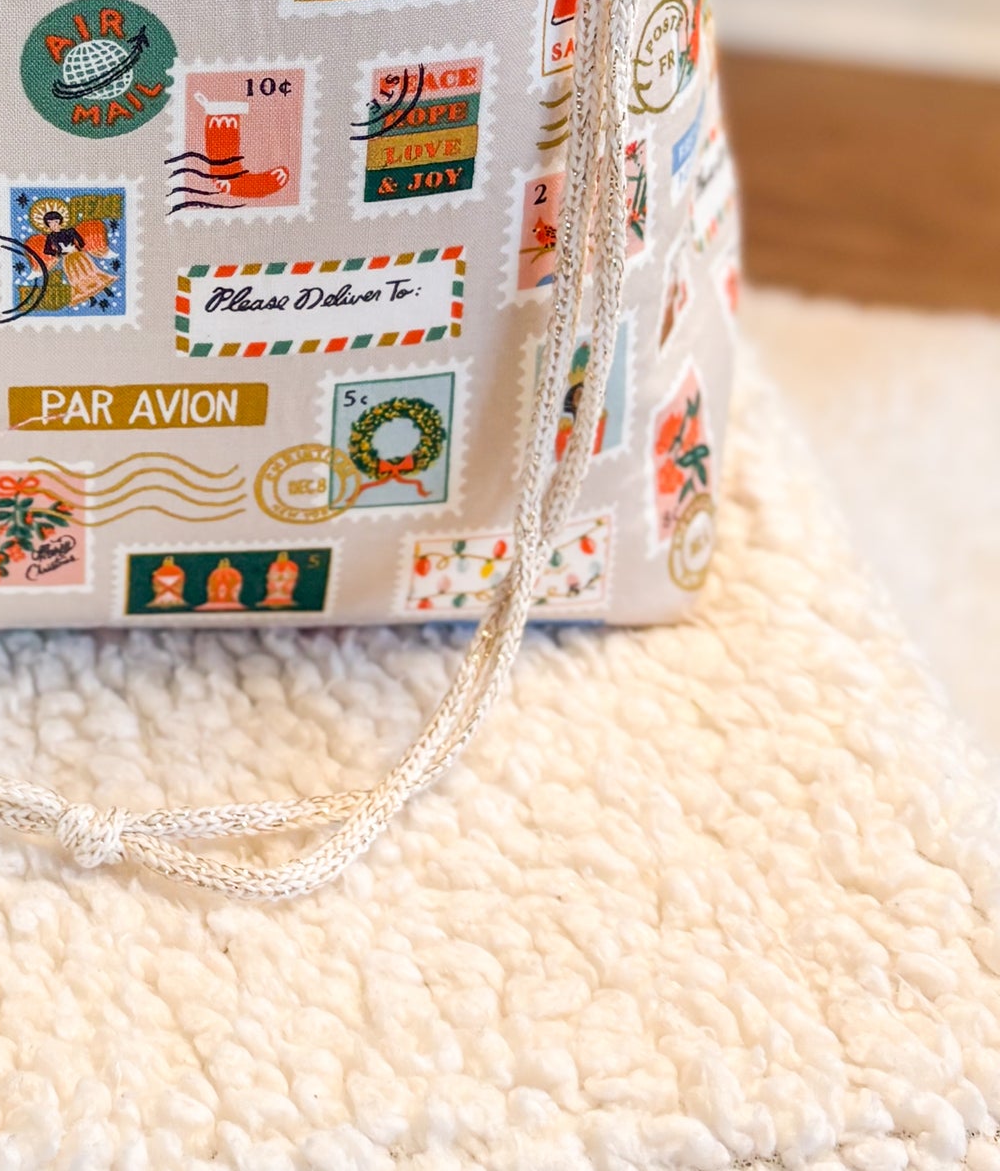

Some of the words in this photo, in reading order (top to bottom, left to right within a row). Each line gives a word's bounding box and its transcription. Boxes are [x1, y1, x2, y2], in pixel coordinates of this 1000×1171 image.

[44, 8, 126, 65] AIR
[658, 50, 676, 77] FR
[244, 77, 293, 97] 10¢
[71, 83, 164, 125] MAIL
[383, 101, 468, 130] HOPE
[384, 139, 463, 167] LOVE
[377, 176, 398, 195] &
[407, 167, 463, 191] JOY
[533, 183, 548, 205] 2
[204, 285, 291, 313] Please
[292, 283, 382, 311] Deliver
[41, 389, 114, 425] PAR
[128, 388, 239, 425] AVION
